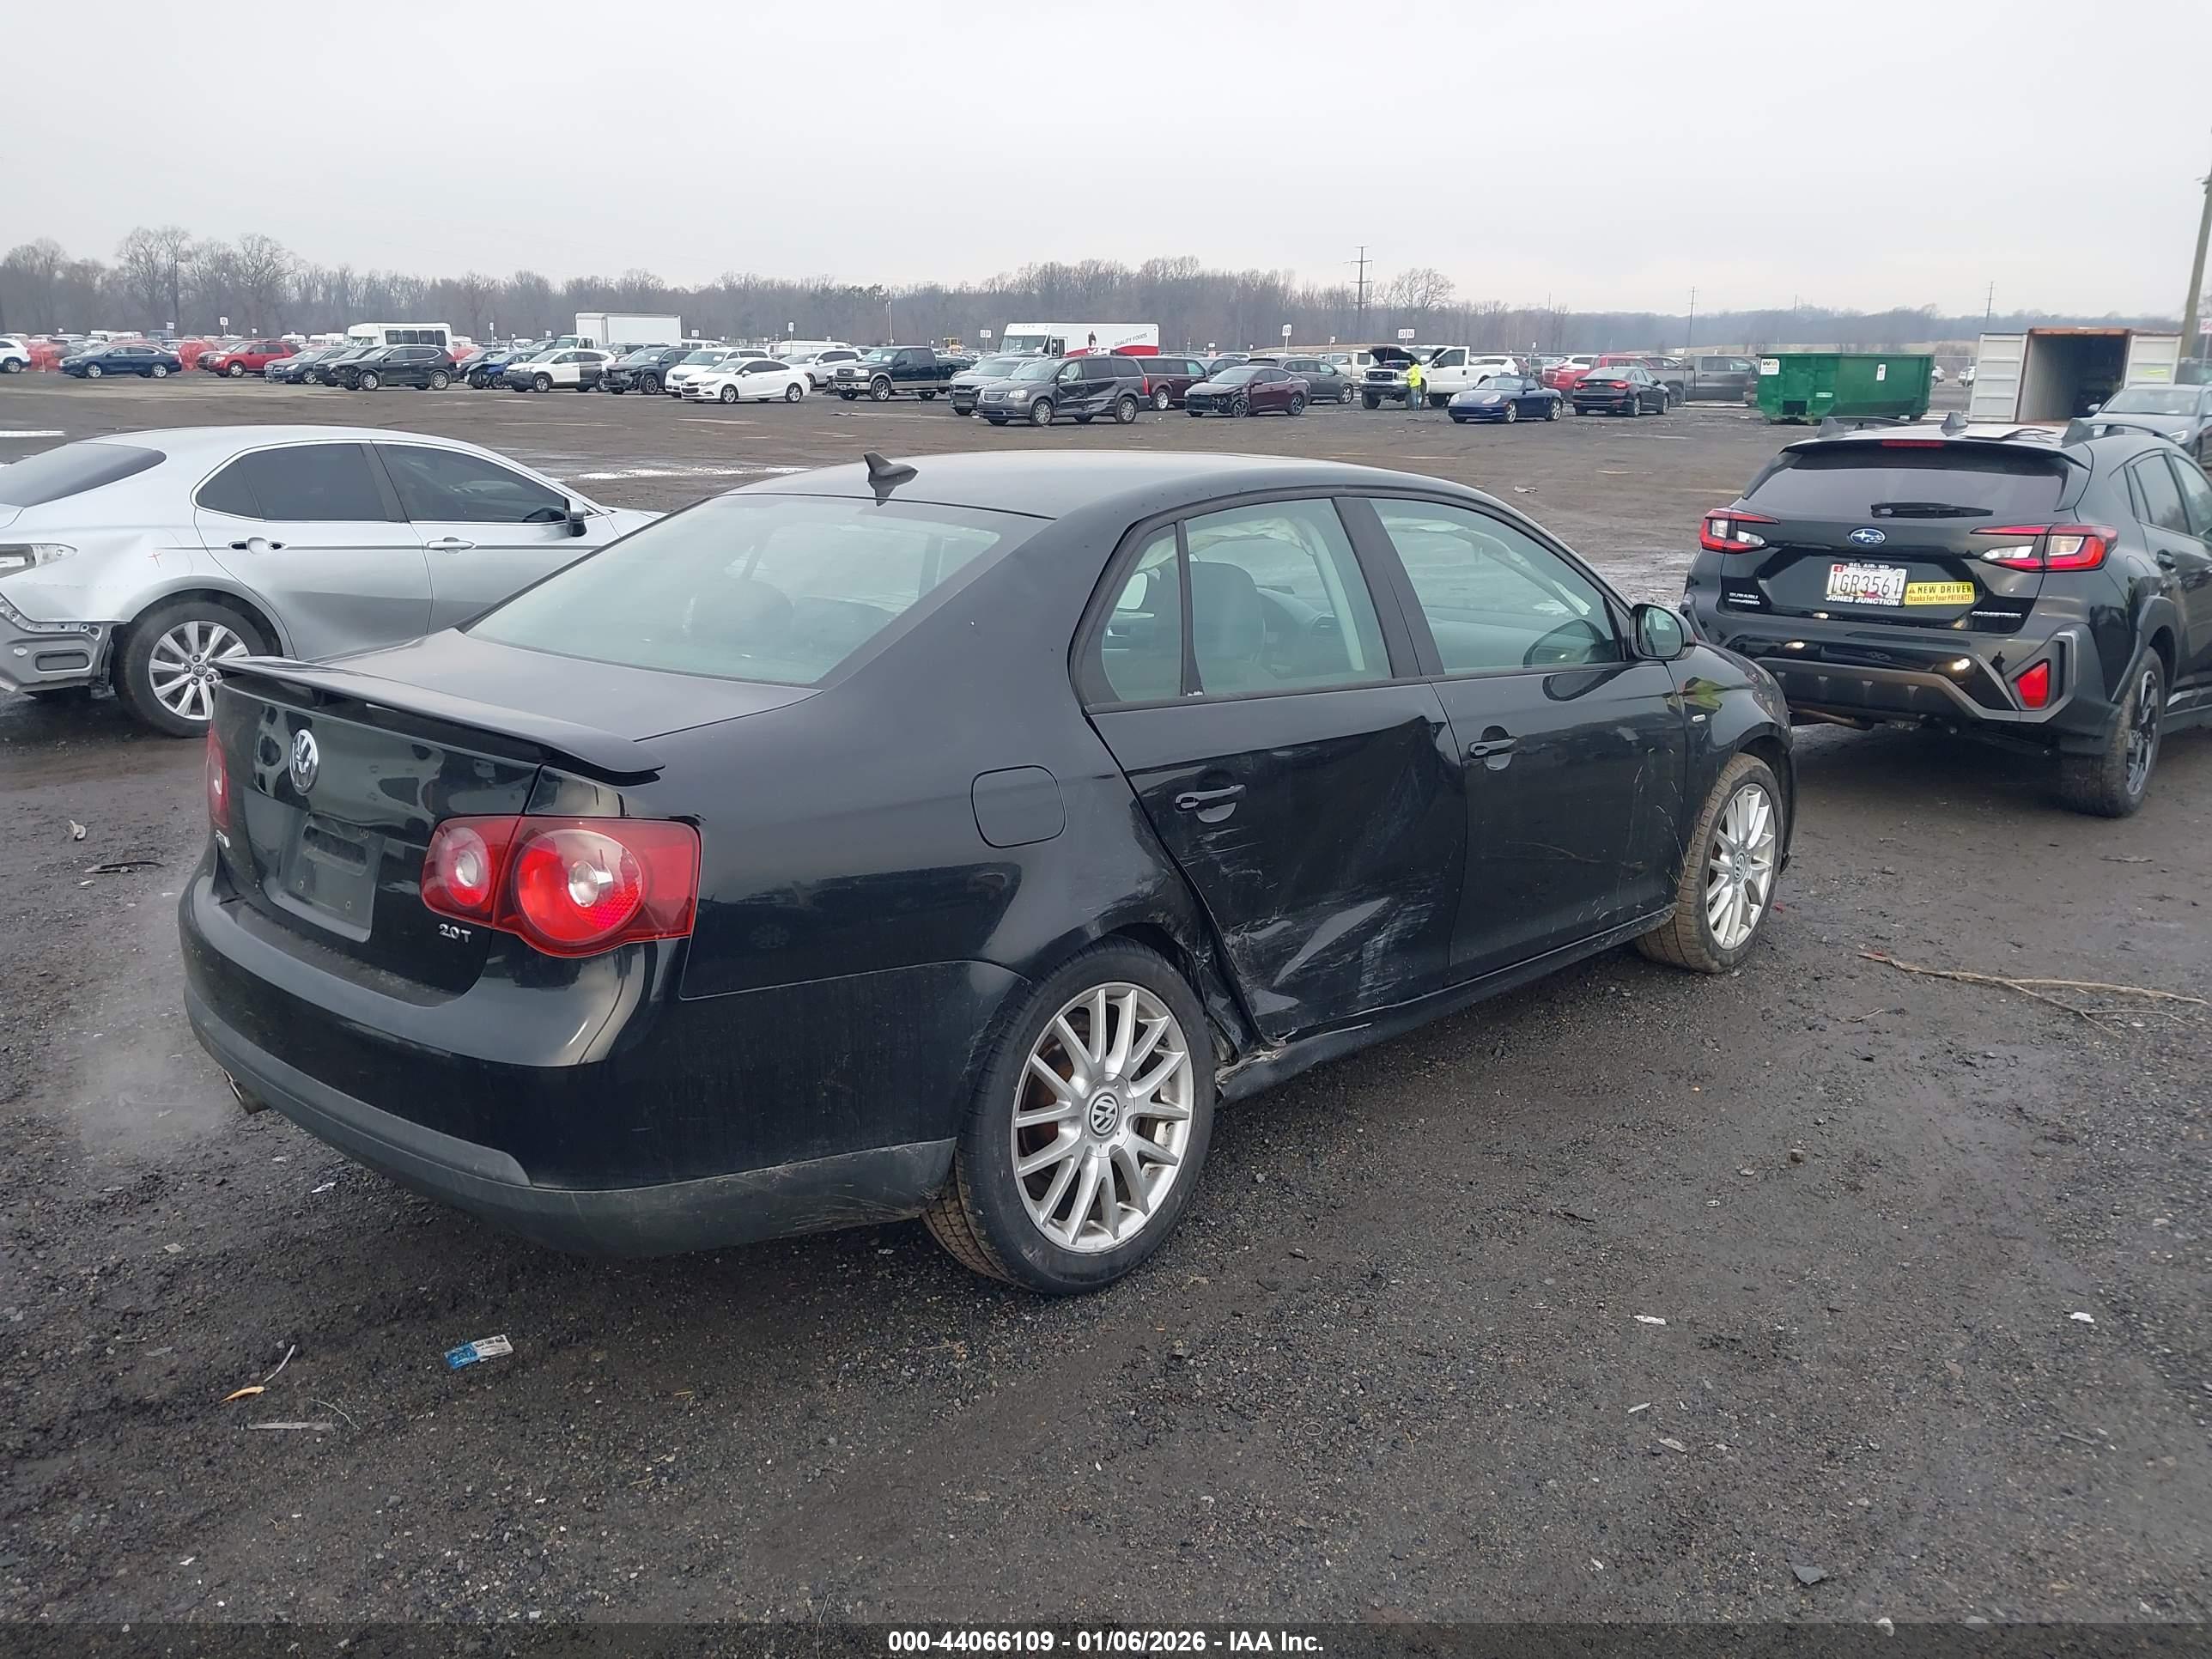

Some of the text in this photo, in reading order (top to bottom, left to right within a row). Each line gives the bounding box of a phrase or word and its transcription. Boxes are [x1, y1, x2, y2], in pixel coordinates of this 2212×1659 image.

[1115, 337, 1132, 346] QUALITY
[1830, 573, 1902, 594] 1GR3561
[1941, 585, 1972, 593] DRIVER
[1855, 596, 1899, 606] JUNCTION
